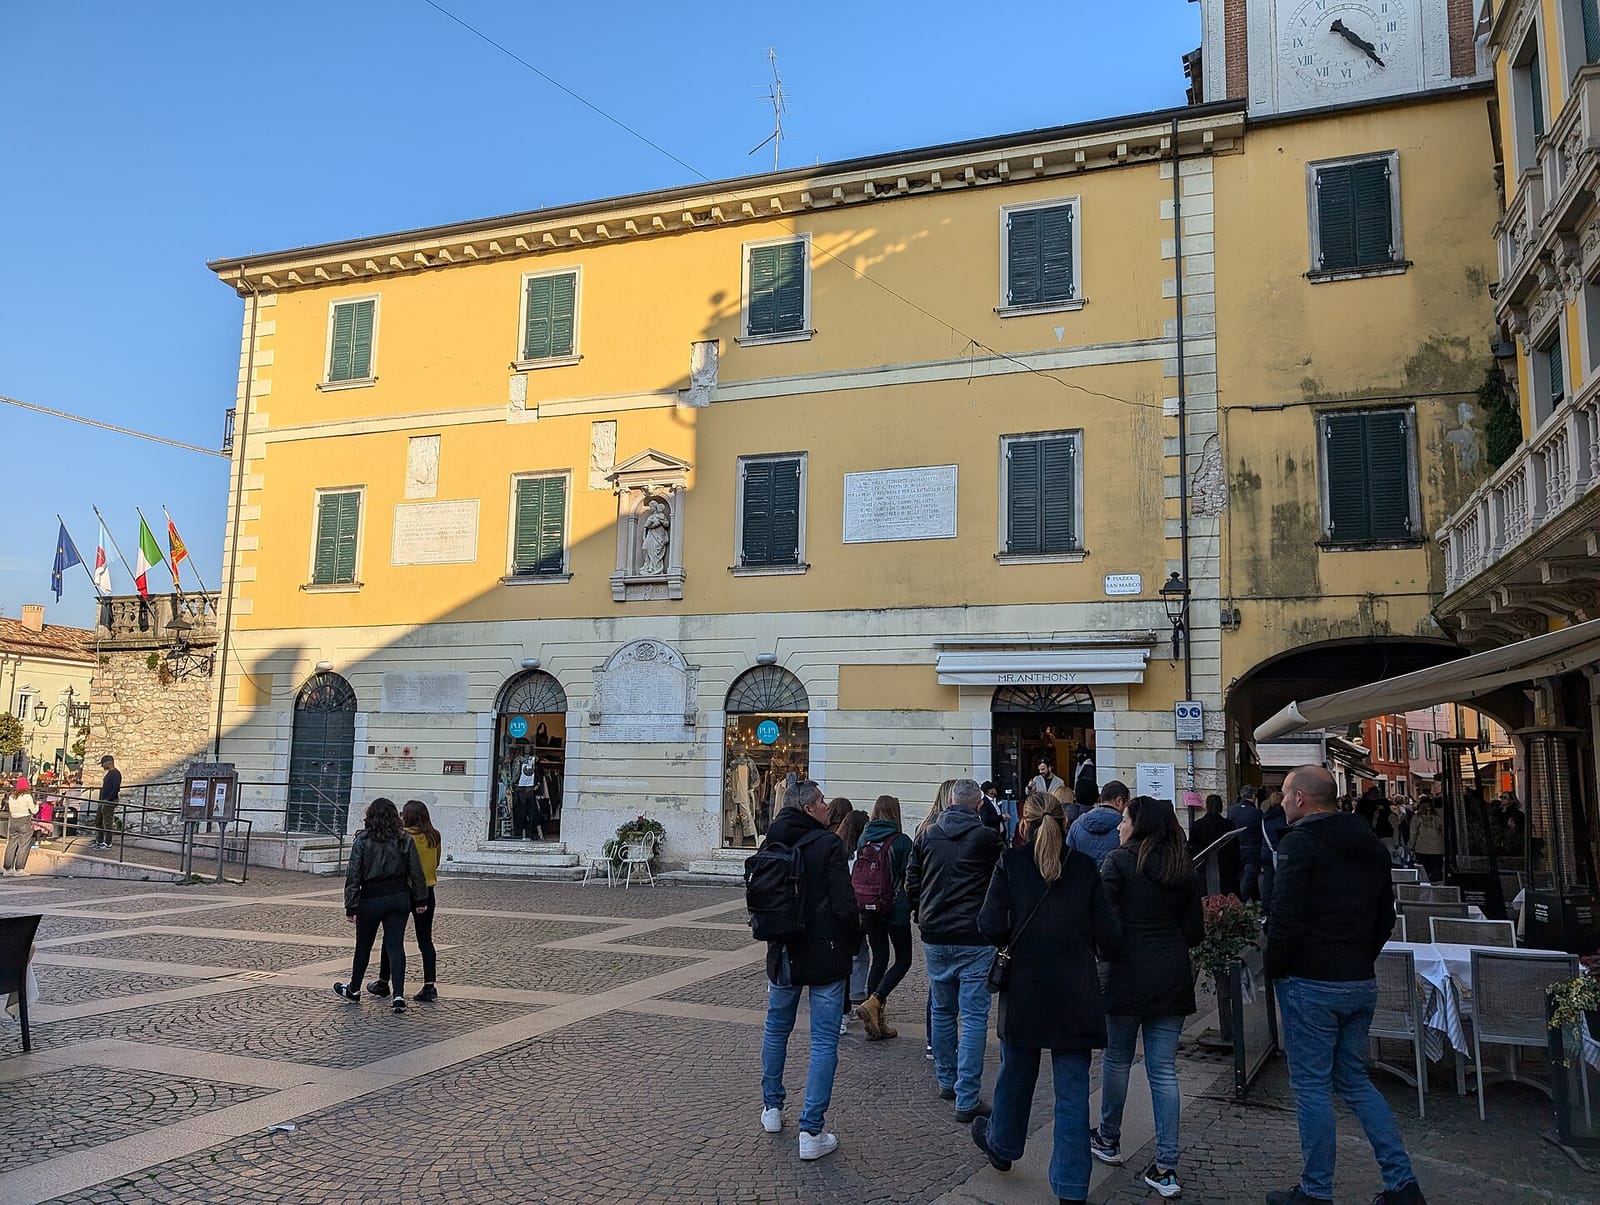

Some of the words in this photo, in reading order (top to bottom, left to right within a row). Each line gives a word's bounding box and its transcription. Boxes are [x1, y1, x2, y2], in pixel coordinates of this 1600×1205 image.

[1381, 3, 1388, 13] II
[1387, 22, 1396, 32] III
[1293, 37, 1304, 48] IX
[1380, 42, 1391, 53] IV
[1298, 55, 1313, 65] VIII
[1365, 60, 1373, 69] V
[1316, 67, 1329, 77] VII
[1341, 68, 1352, 78] VI
